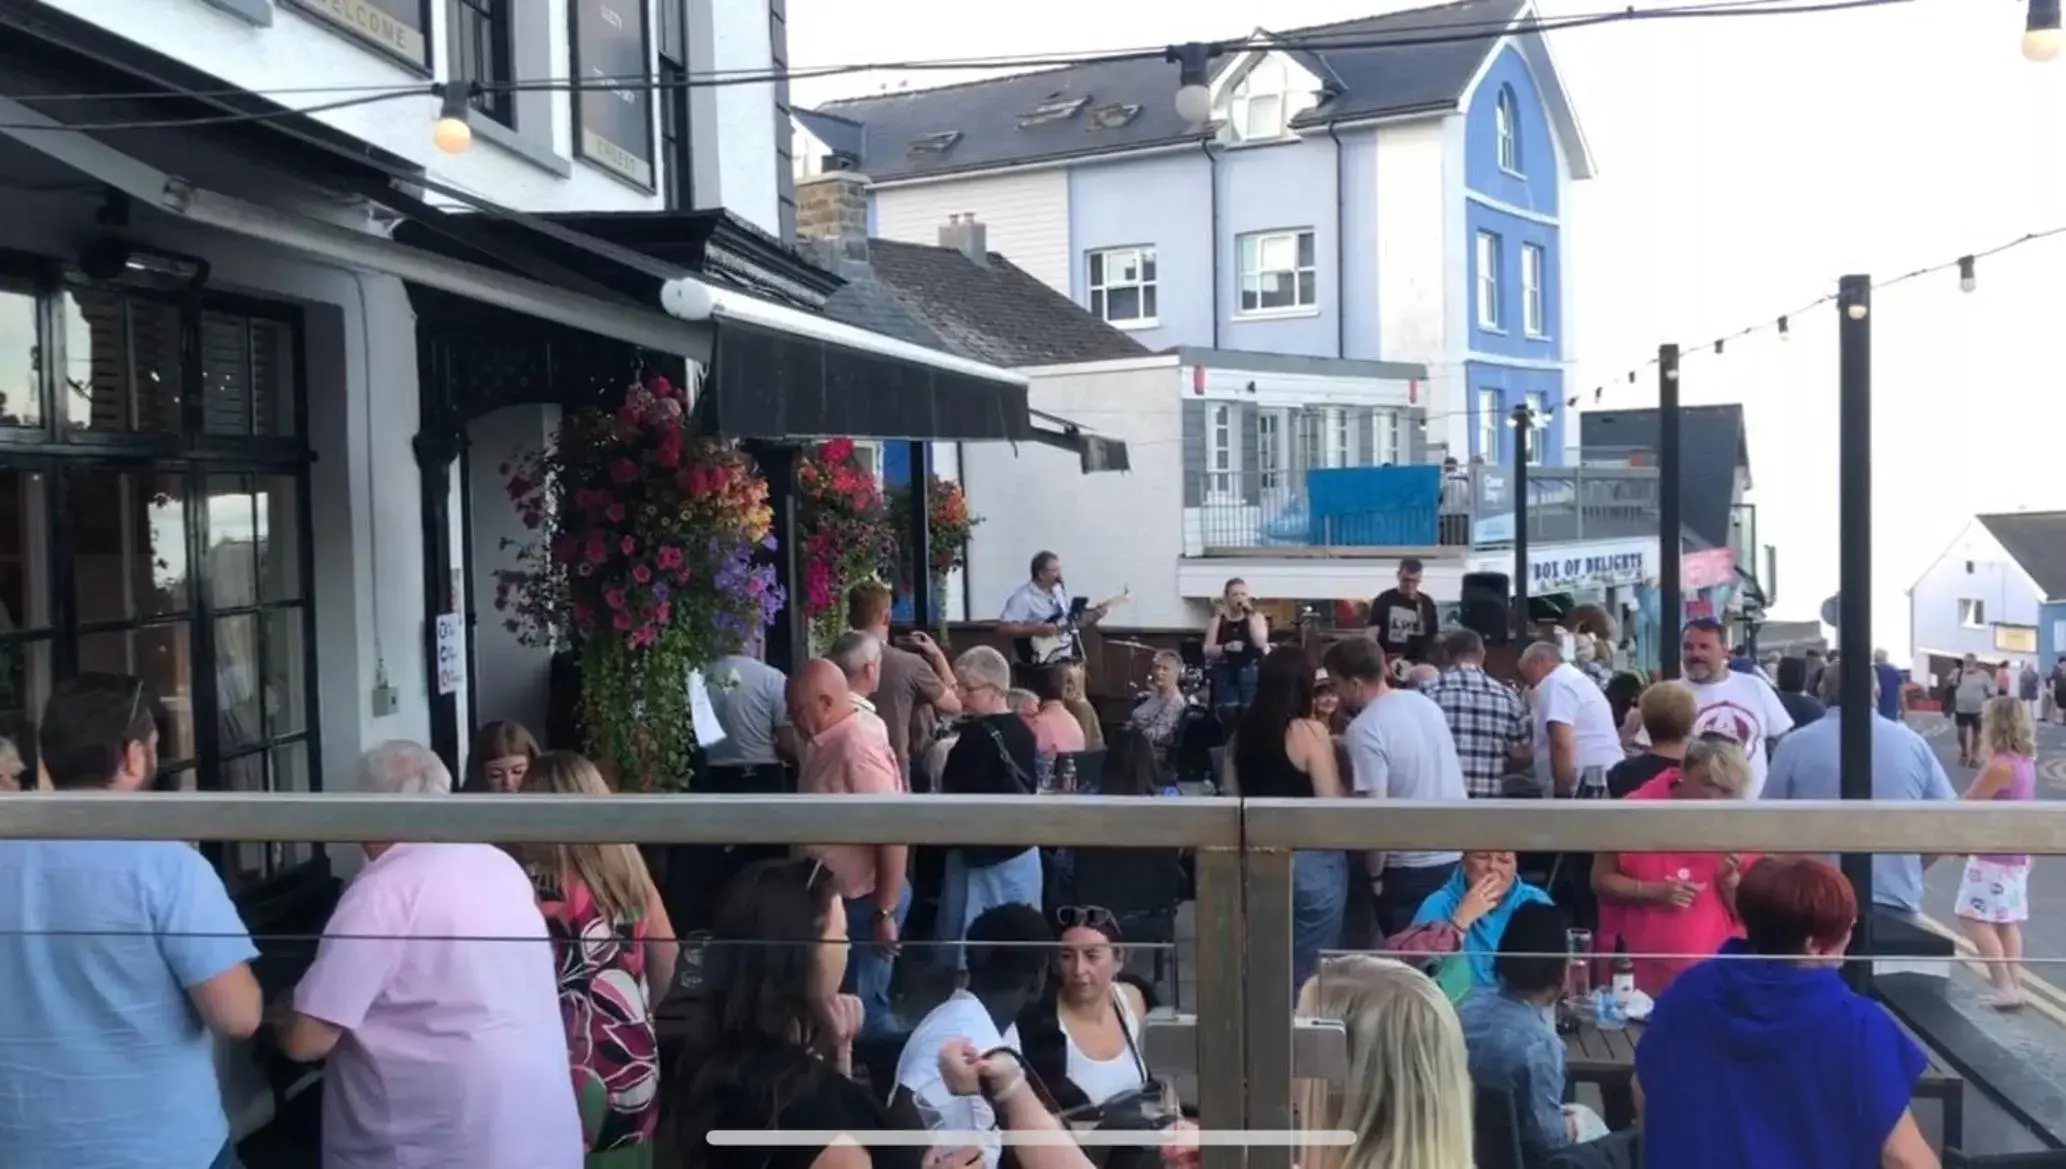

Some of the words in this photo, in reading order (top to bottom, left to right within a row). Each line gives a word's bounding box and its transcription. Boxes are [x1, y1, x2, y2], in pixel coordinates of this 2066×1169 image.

[321, 0, 406, 49] ELCOME
[1534, 560, 1559, 580] BOX
[1565, 557, 1581, 577] OF
[1585, 552, 1642, 574] DELIGHTS
